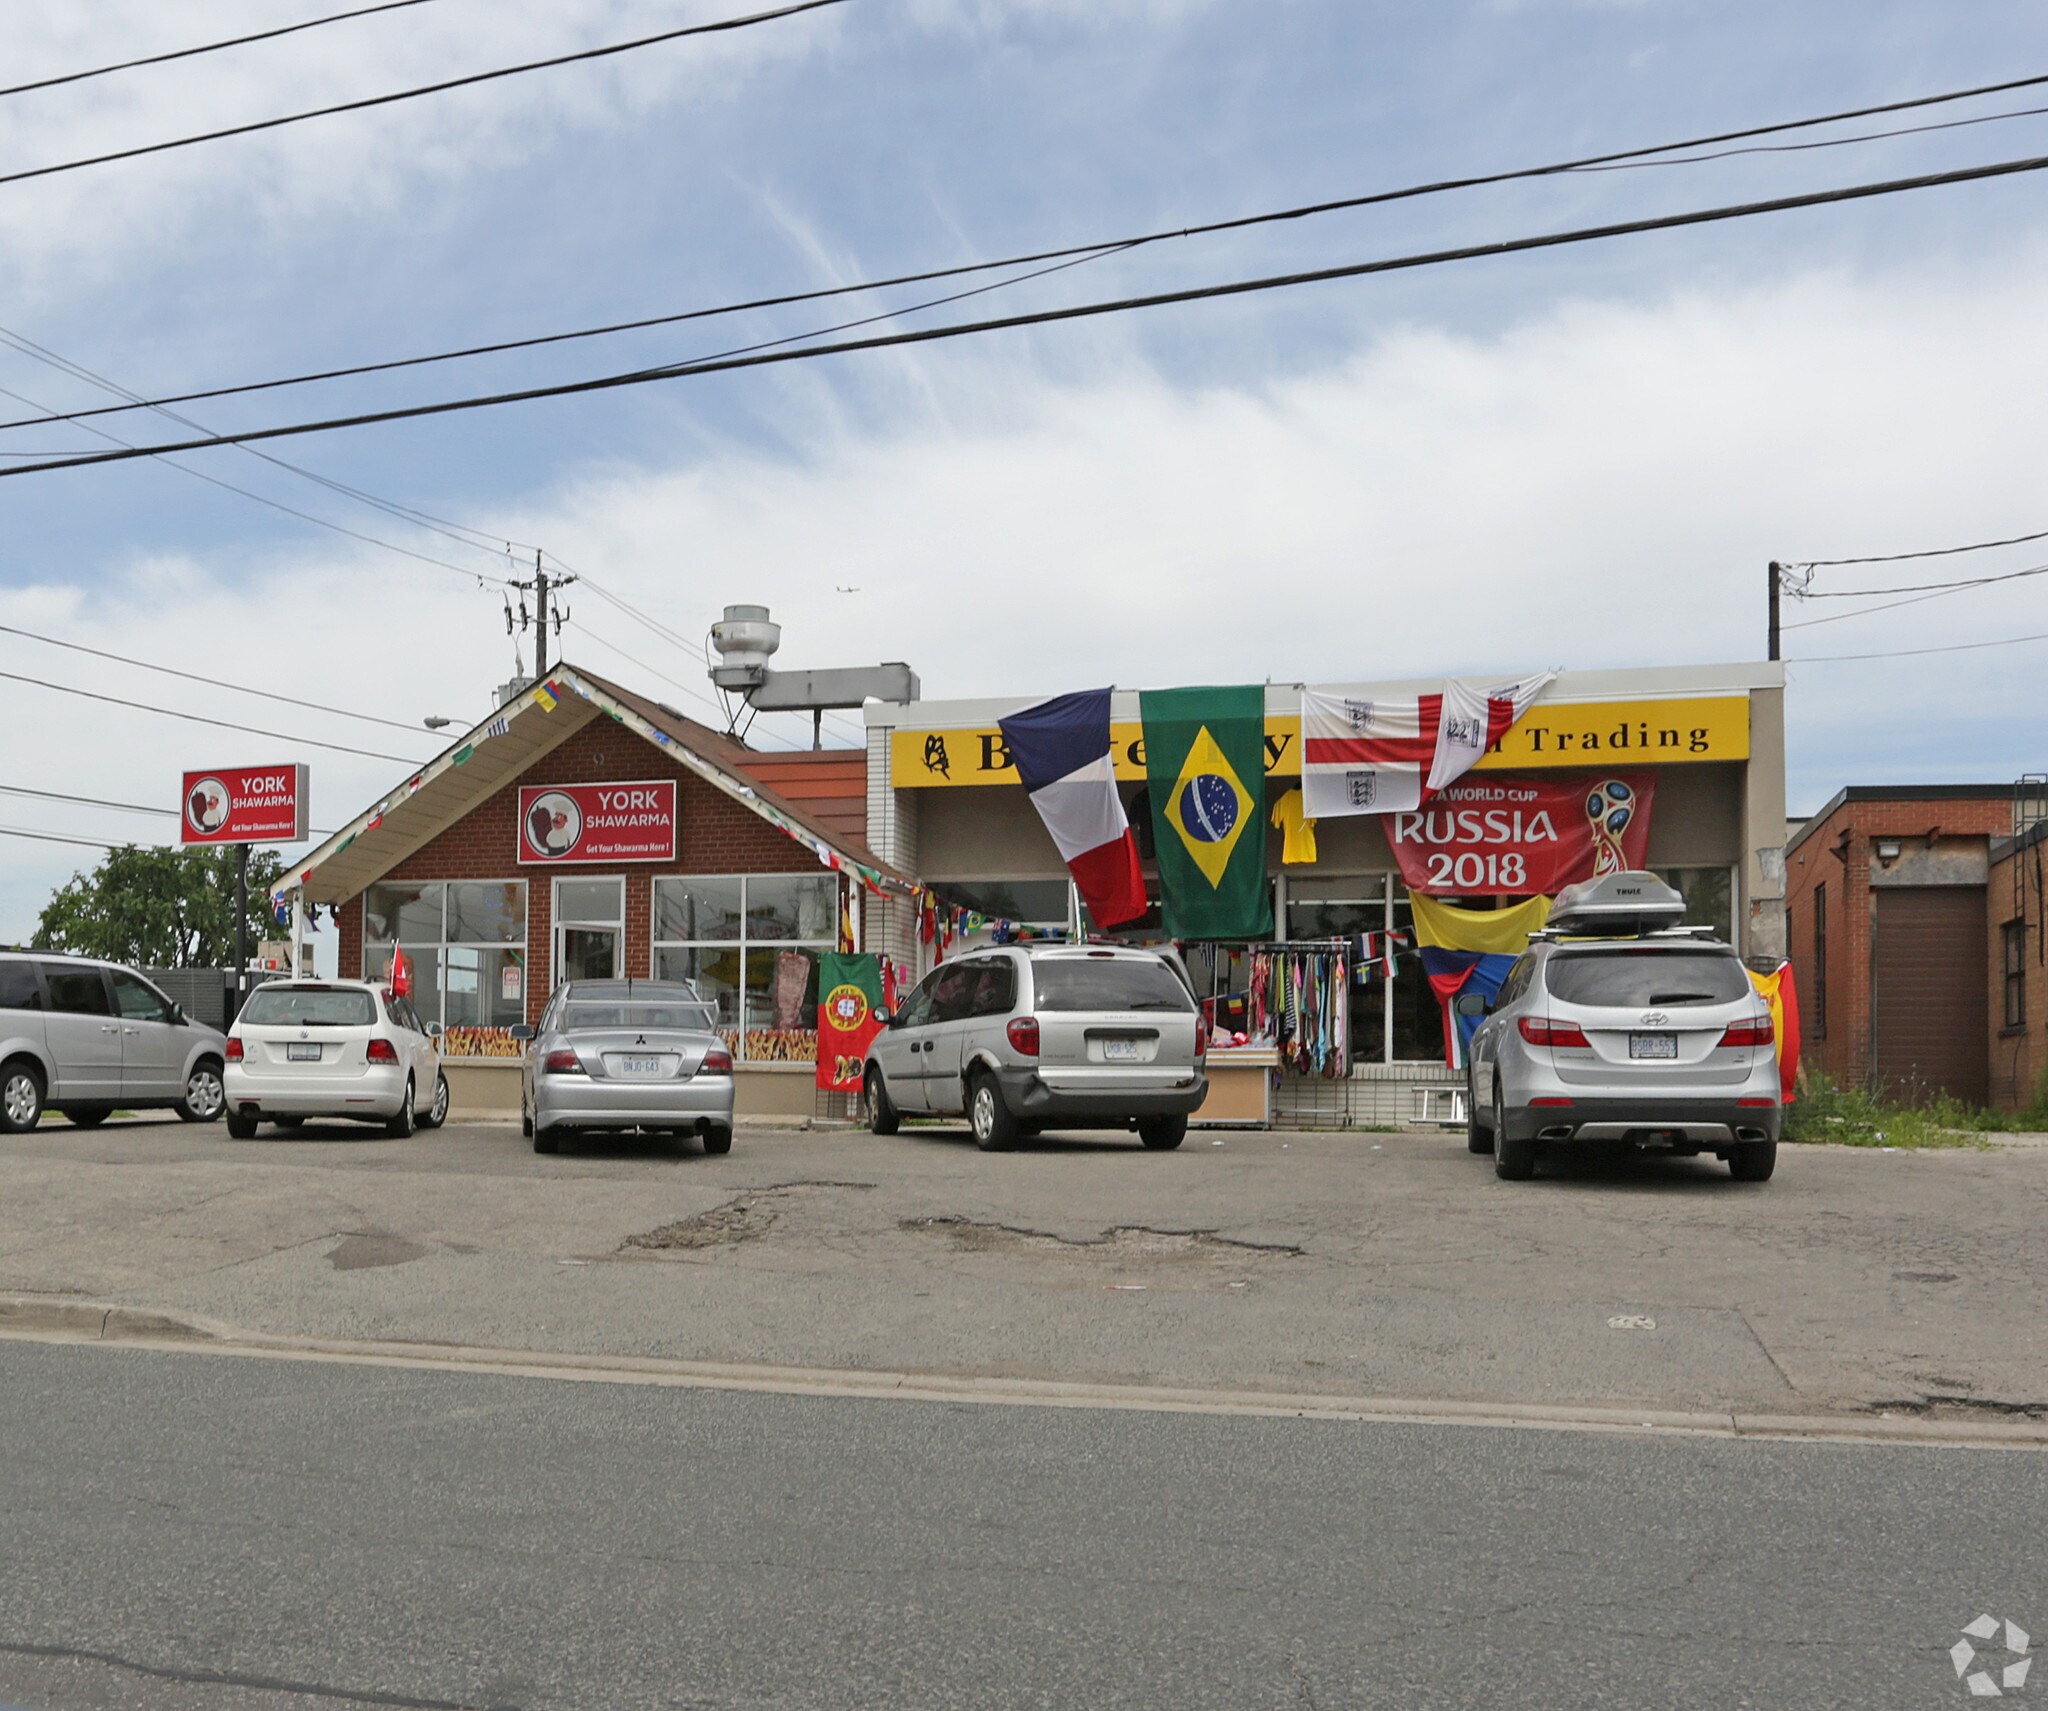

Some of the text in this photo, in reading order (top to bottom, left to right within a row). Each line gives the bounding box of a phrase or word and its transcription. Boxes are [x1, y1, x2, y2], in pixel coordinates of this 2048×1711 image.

[1525, 722, 1710, 752] Trading
[241, 775, 287, 794] YORK
[232, 795, 294, 809] SHAWARMA
[598, 790, 658, 810] YORK
[1450, 788, 1505, 801] WORLD
[1508, 789, 1538, 802] CUP
[231, 823, 241, 832] Get
[586, 813, 670, 828] SHAWARMA
[1395, 810, 1558, 844] RUSSIA
[586, 844, 598, 854] Get
[598, 843, 613, 853] Your
[614, 843, 649, 853] Shawarma
[649, 842, 665, 851] Here
[1427, 853, 1527, 887] 2018
[1616, 888, 1641, 896] THULE
